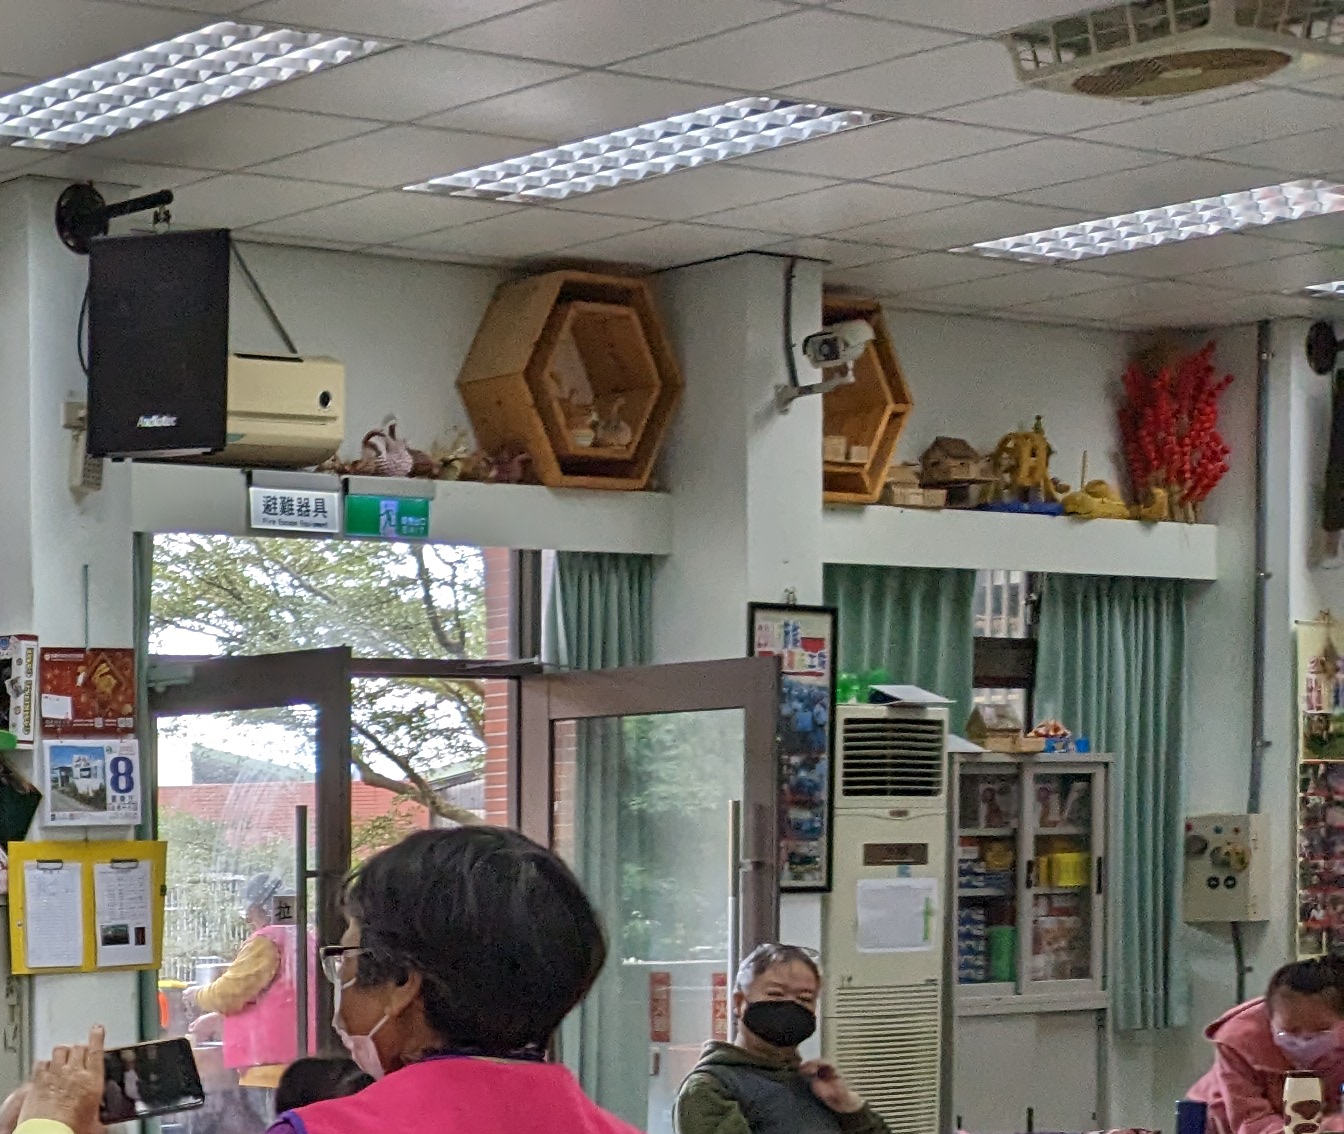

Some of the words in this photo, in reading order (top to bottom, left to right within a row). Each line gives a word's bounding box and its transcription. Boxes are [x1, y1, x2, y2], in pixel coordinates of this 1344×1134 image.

[262, 495, 327, 518] 避難器具
[110, 757, 135, 794] 8
[275, 900, 293, 921] 拉
